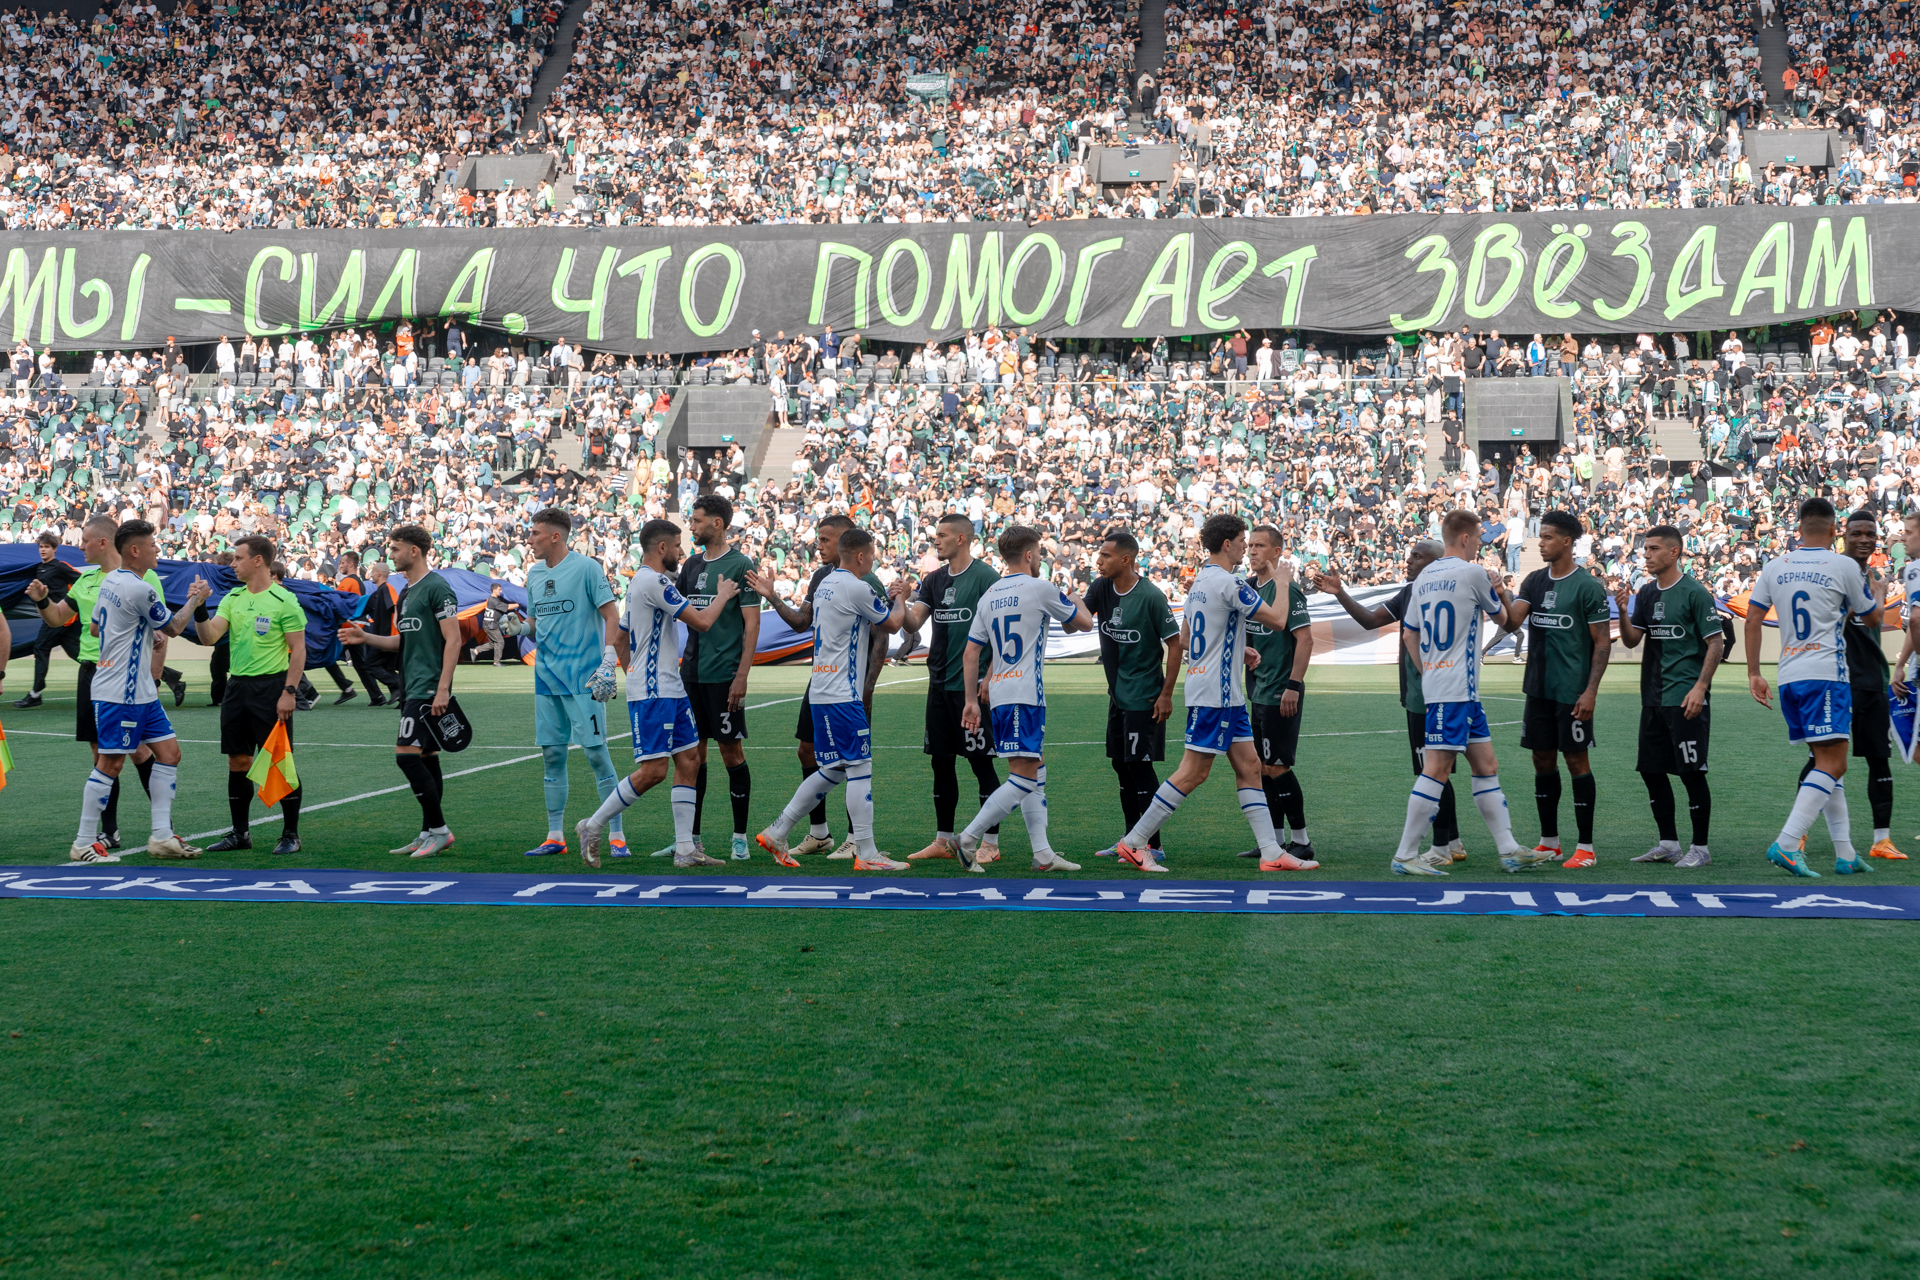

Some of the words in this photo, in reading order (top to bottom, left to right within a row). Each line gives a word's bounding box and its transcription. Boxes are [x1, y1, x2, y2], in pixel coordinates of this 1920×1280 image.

[0, 246, 151, 345] МЫ
[551, 240, 745, 340] ЧТО
[1777, 571, 1833, 588] ФЕРНАНДЕС
[537, 604, 560, 613] Winline
[1791, 590, 1811, 640] 6
[1420, 600, 1455, 653] 50
[1650, 628, 1670, 636] inline
[991, 614, 1023, 665] 15
[399, 716, 415, 738] 10
[590, 714, 599, 736] 1
[719, 712, 732, 734] 3
[1436, 703, 1444, 730] BetBoo
[824, 714, 835, 747] BetBoom
[965, 728, 986, 752] 53
[1428, 733, 1443, 742] ВТБ
[1571, 720, 1585, 743] 6
[1815, 725, 1832, 735] ВТБ
[1004, 741, 1019, 750] ВТБ
[1128, 732, 1139, 755] 7
[1678, 741, 1698, 764] 15
[824, 751, 838, 760] ВТБ
